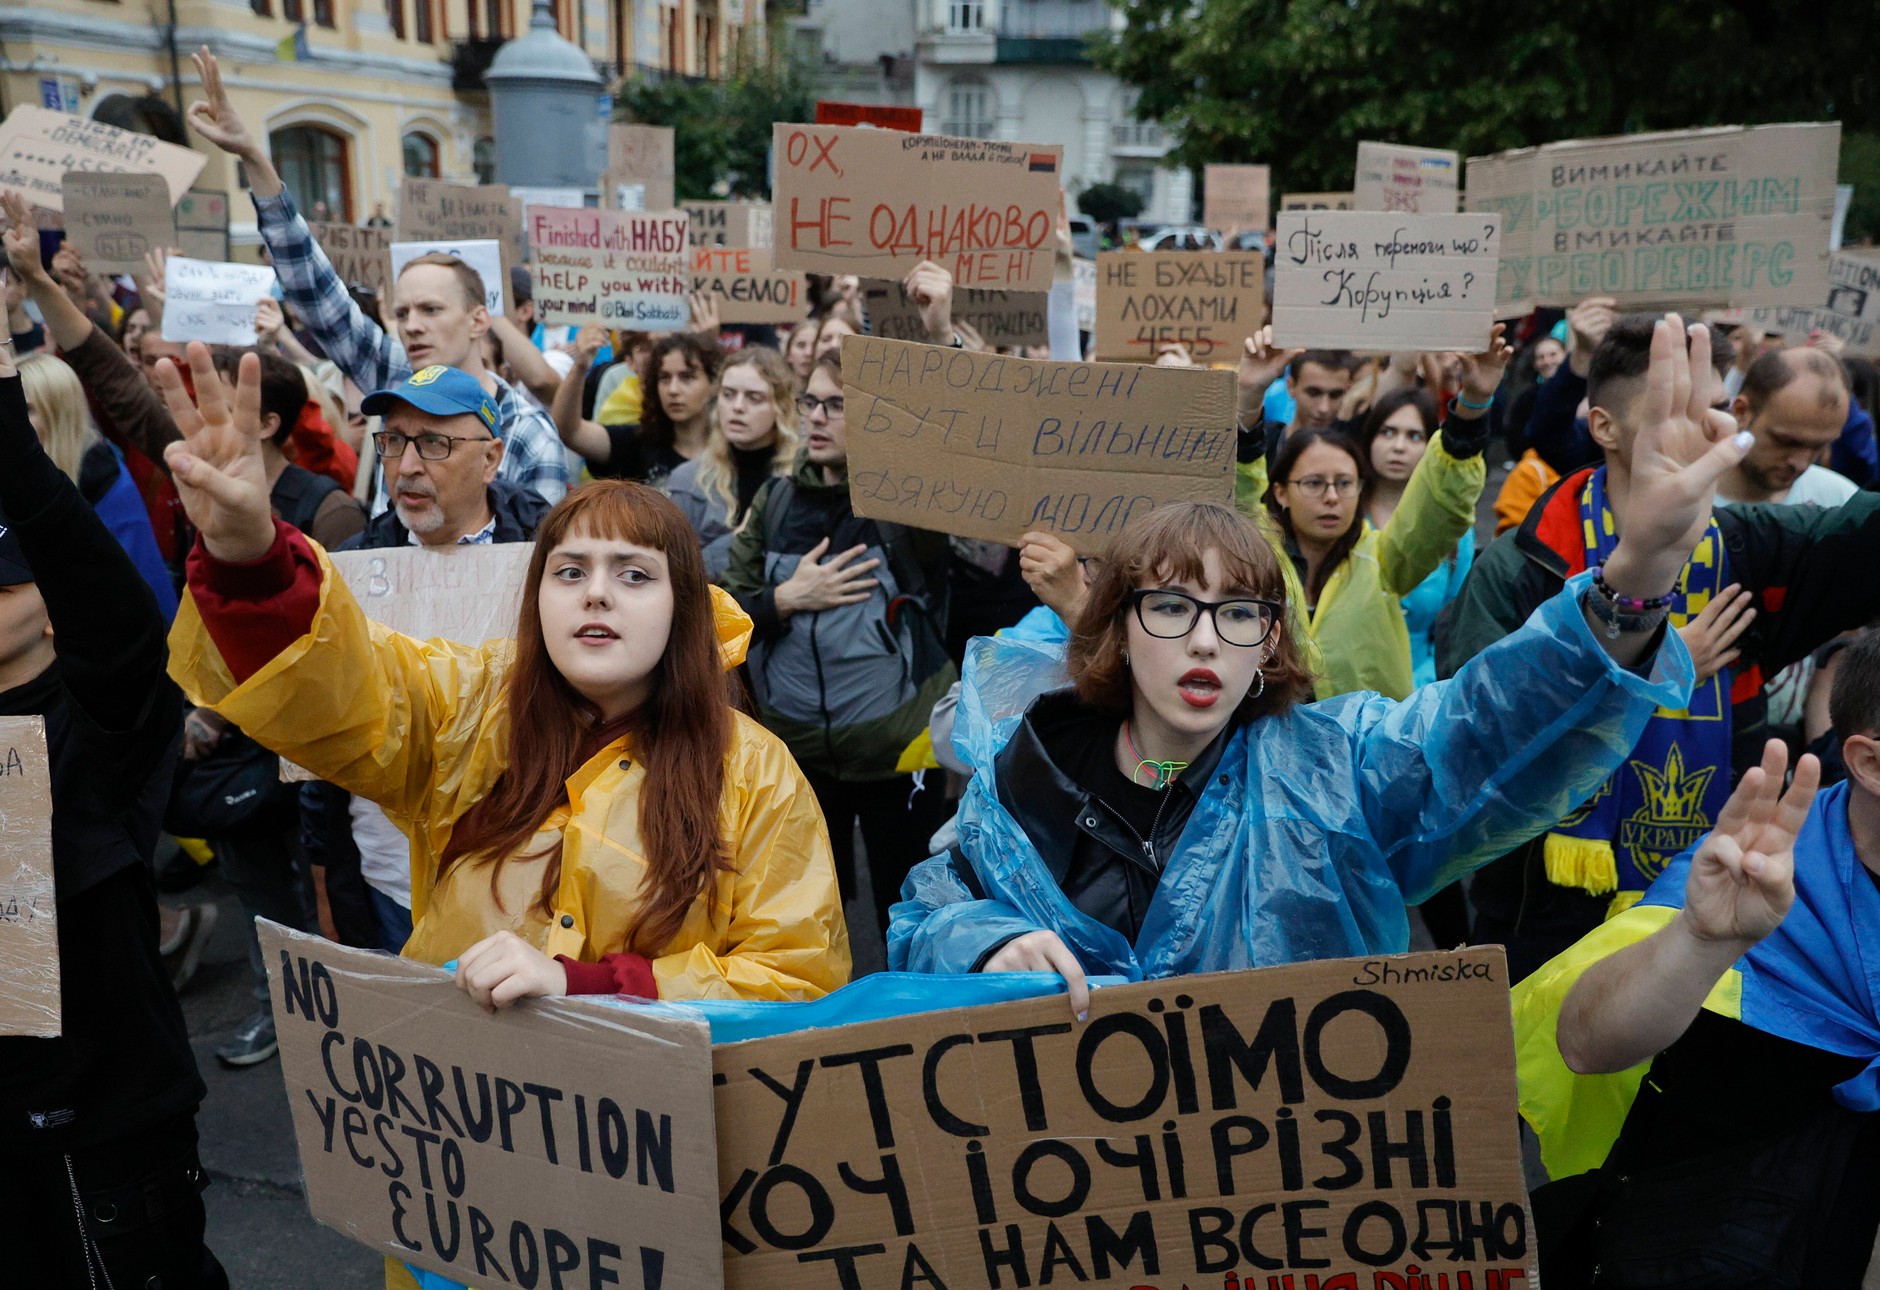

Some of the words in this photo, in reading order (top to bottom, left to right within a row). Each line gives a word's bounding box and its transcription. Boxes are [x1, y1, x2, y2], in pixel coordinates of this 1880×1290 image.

[787, 131, 845, 178] ОХ,
[1552, 154, 1729, 188] ВИМИКАЙТЕ
[535, 215, 600, 249] Finished
[632, 220, 688, 253] НАБУ
[790, 197, 853, 249] НЕ
[869, 203, 1050, 261] ОДНАКОВО
[1555, 223, 1736, 252] ВМИКАЙТЕ
[955, 251, 1034, 284] МЕНІ
[1107, 262, 1136, 287] НЕ
[1155, 260, 1254, 288] БУДЬТЕ
[601, 280, 632, 297] you
[538, 299, 564, 318] your
[568, 294, 597, 314] mind
[1120, 294, 1238, 323] ЛОХАМИ
[864, 396, 1002, 453] БУТИ
[280, 949, 338, 1029] NO
[1353, 958, 1494, 986] Shmiska
[321, 1032, 675, 1193] CORRUPTION
[797, 1241, 951, 1290] ТА
[978, 1211, 1161, 1290] НАМ
